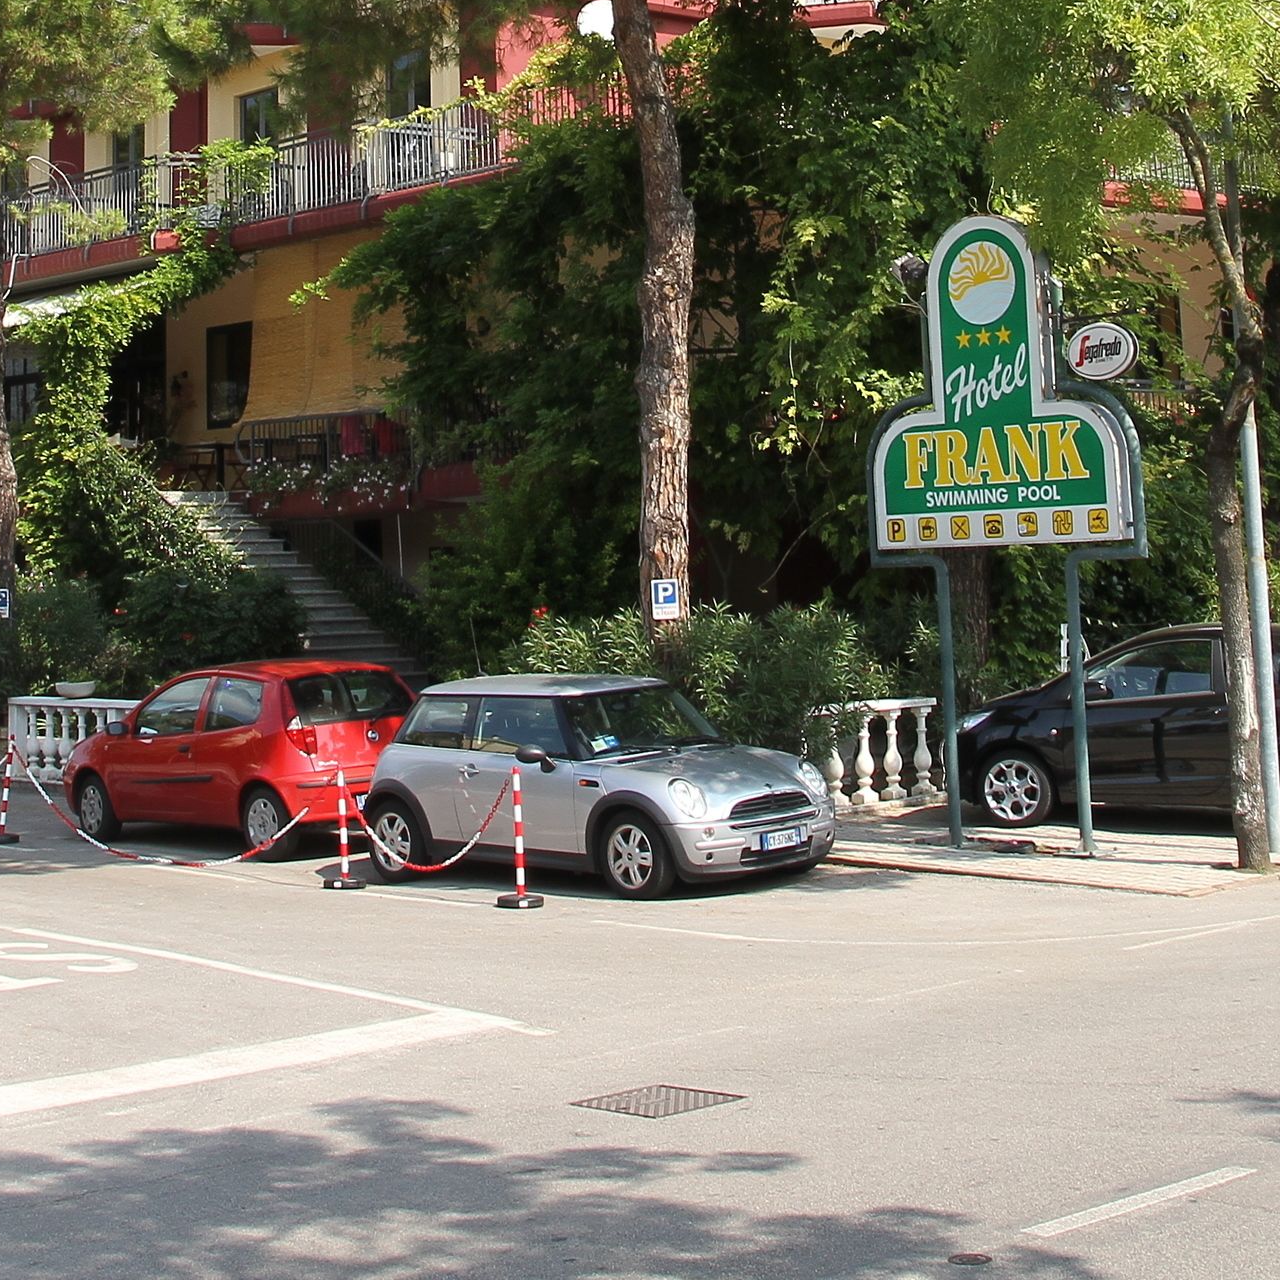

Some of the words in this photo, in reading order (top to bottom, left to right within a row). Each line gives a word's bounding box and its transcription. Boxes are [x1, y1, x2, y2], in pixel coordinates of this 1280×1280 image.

[1075, 335, 1122, 367] Segafredo
[945, 343, 1028, 422] Hotel
[903, 420, 1090, 489] FRANK
[926, 488, 1008, 508] SWIMMING
[1018, 485, 1061, 502] POOL
[658, 584, 673, 603] P
